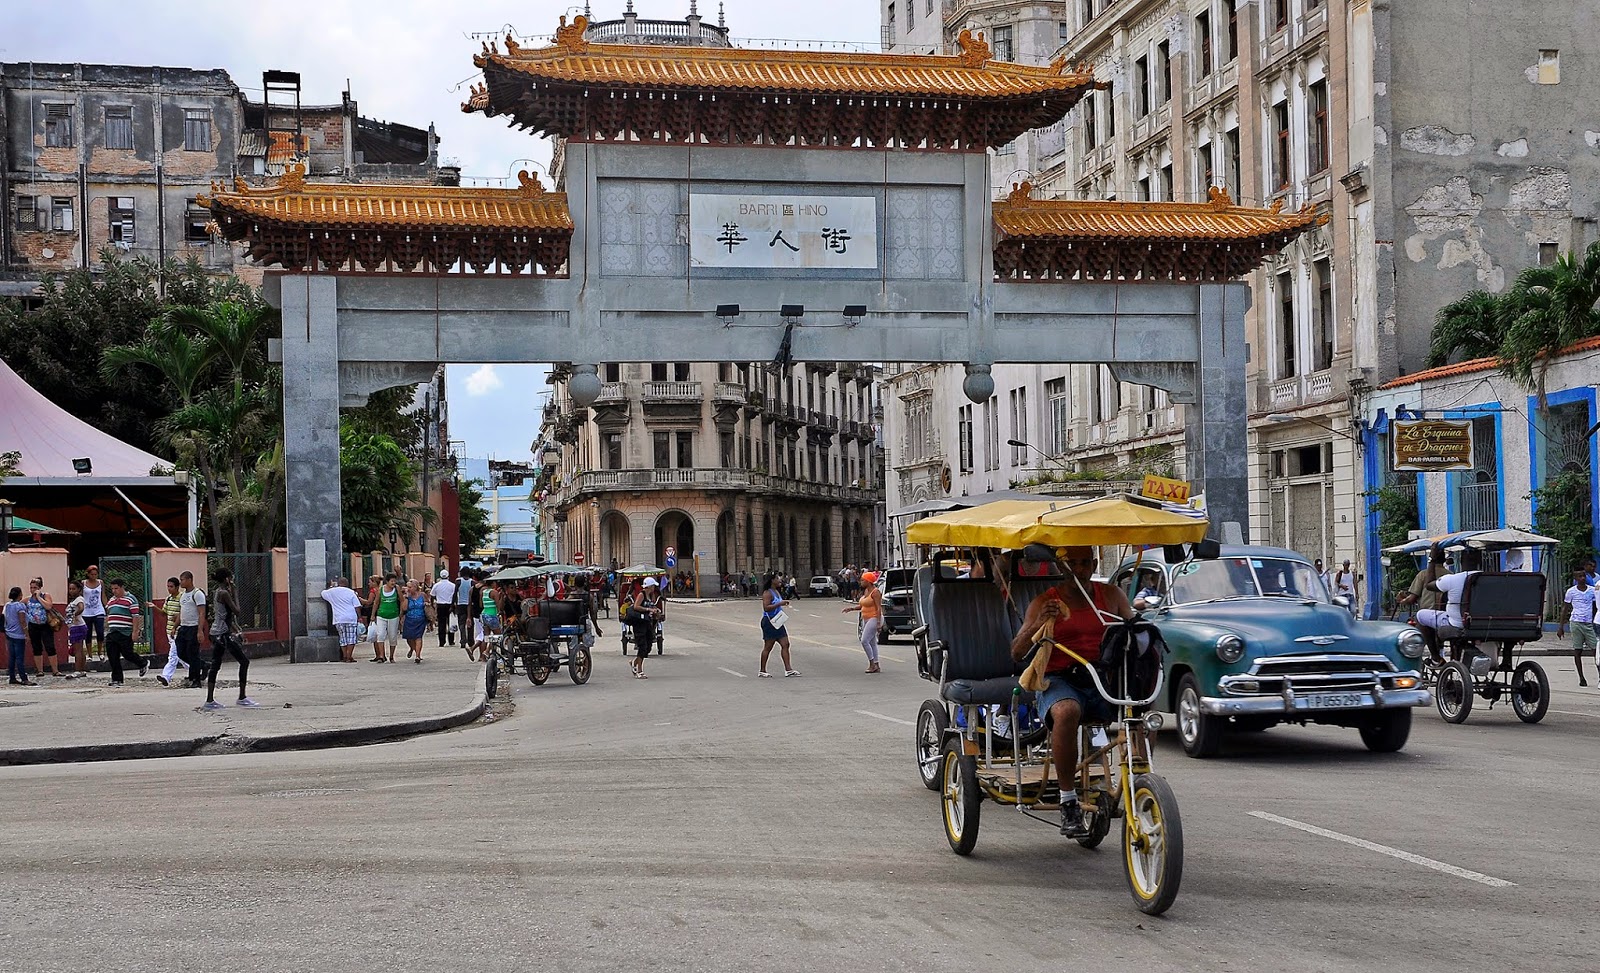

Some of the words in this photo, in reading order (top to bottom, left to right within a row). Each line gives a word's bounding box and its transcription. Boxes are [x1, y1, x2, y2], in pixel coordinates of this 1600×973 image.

[739, 203, 778, 215] BARRI
[1402, 426, 1420, 440] La
[1422, 426, 1462, 441] Esquina
[1402, 444, 1413, 452] de
[1417, 439, 1463, 455] Dragones
[1147, 480, 1188, 499] TAXI
